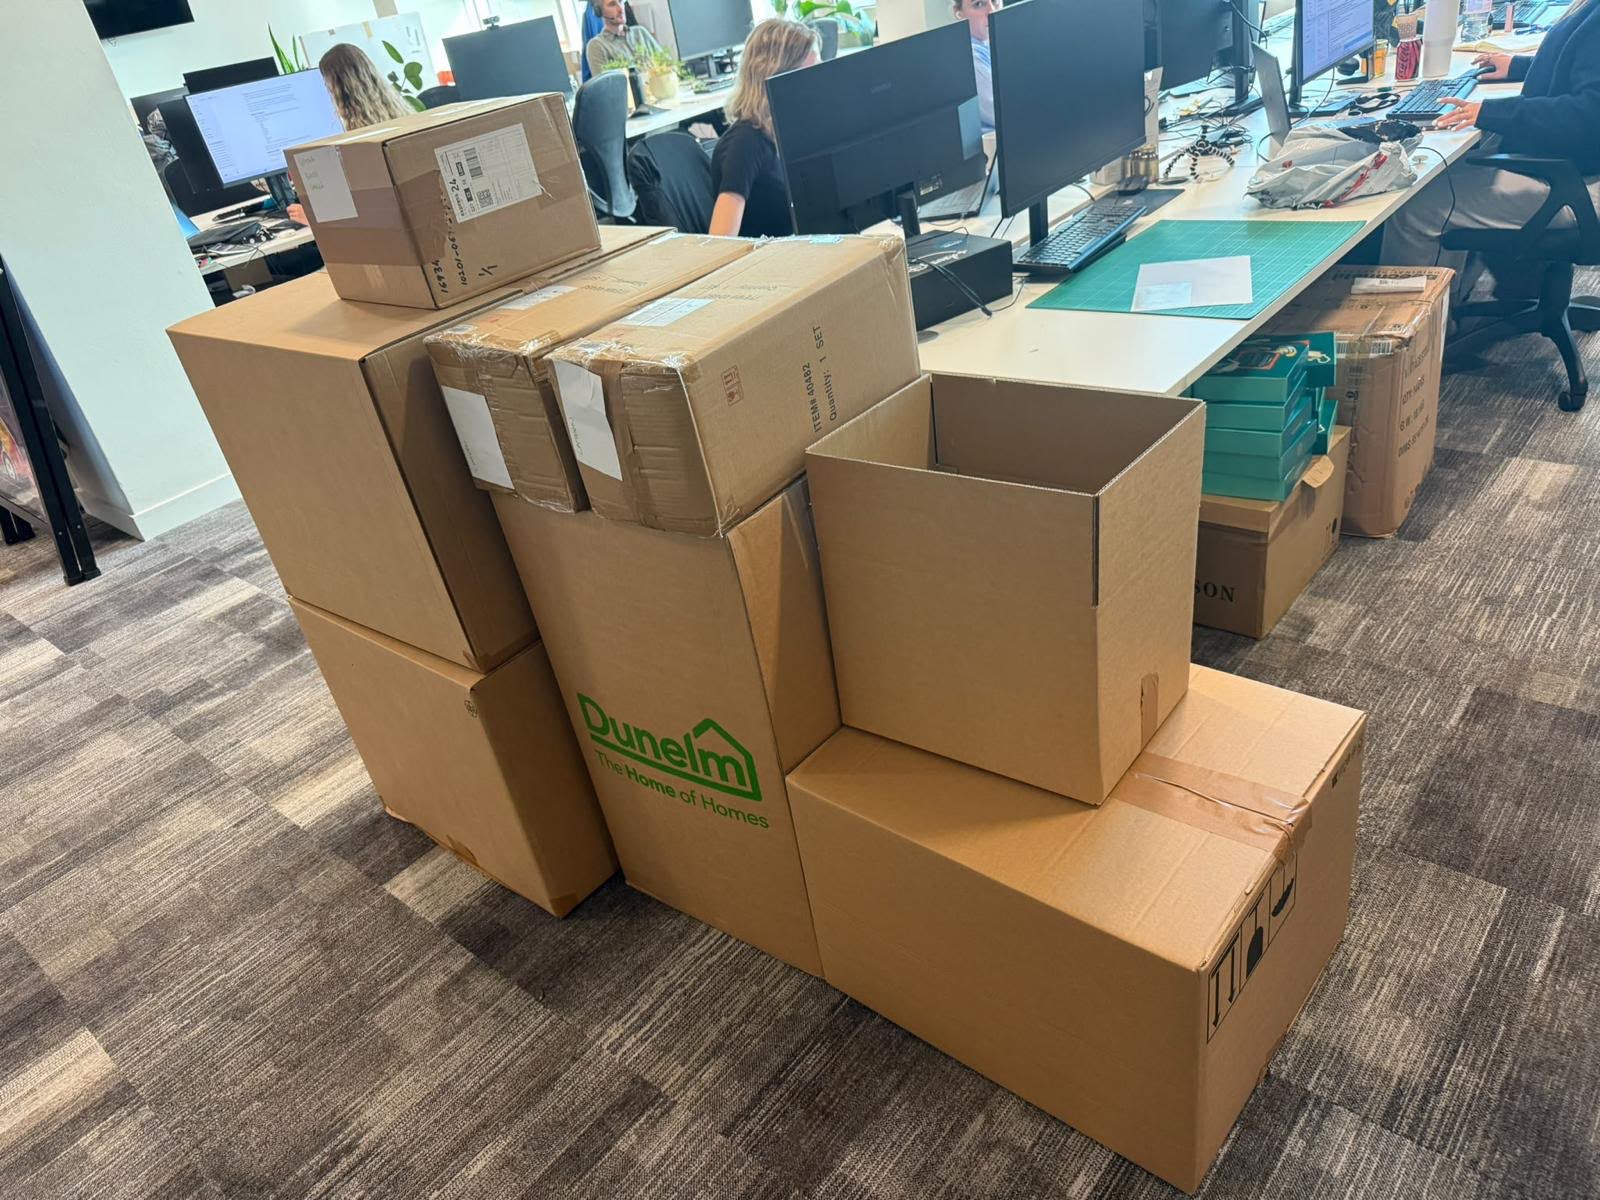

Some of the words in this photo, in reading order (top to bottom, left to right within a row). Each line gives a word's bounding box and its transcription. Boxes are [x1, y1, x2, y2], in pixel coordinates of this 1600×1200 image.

[448, 179, 459, 193] 24
[478, 265, 498, 276] 1/1
[813, 326, 824, 349] SET
[824, 369, 837, 421] Quantity:
[577, 692, 748, 787] Dunelm
[594, 749, 623, 775] The
[624, 765, 676, 798] Home
[680, 790, 697, 806] of
[701, 794, 769, 829] Homes
